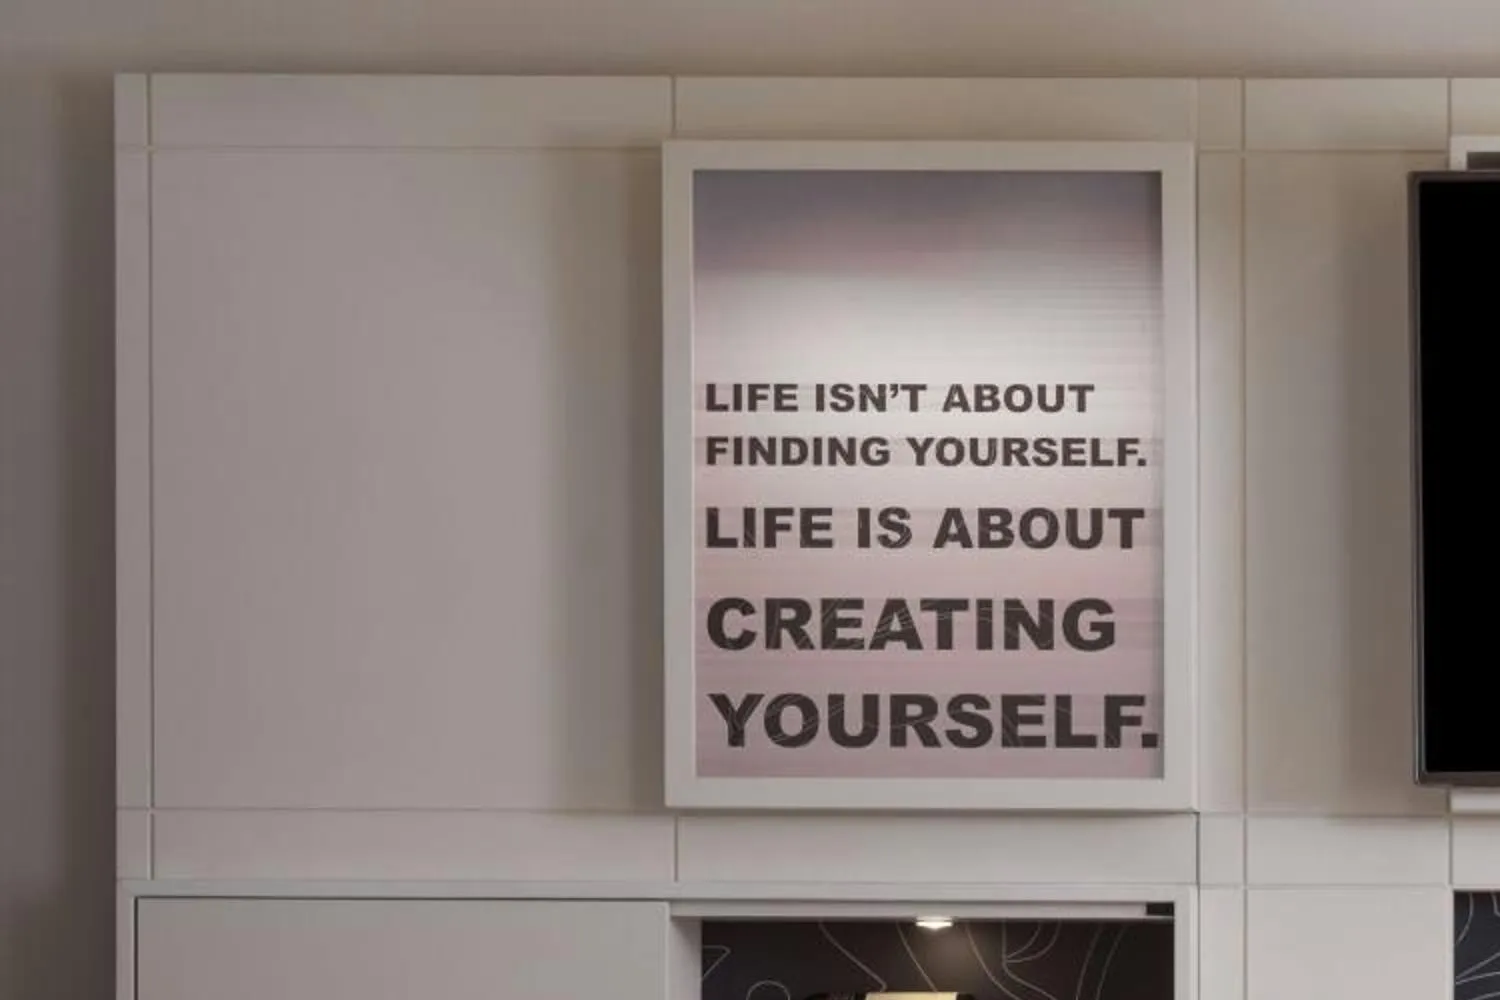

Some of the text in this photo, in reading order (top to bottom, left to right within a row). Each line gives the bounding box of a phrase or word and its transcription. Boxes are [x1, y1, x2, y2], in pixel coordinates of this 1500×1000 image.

[705, 383, 1095, 413] LIFE ISN’T ABOUT
[706, 436, 1147, 466] FINDING YOURSELF.
[706, 507, 1146, 549] LIFE IS ABOUT
[706, 598, 1116, 652] CREATING
[708, 693, 1160, 749] YOURSELF.
